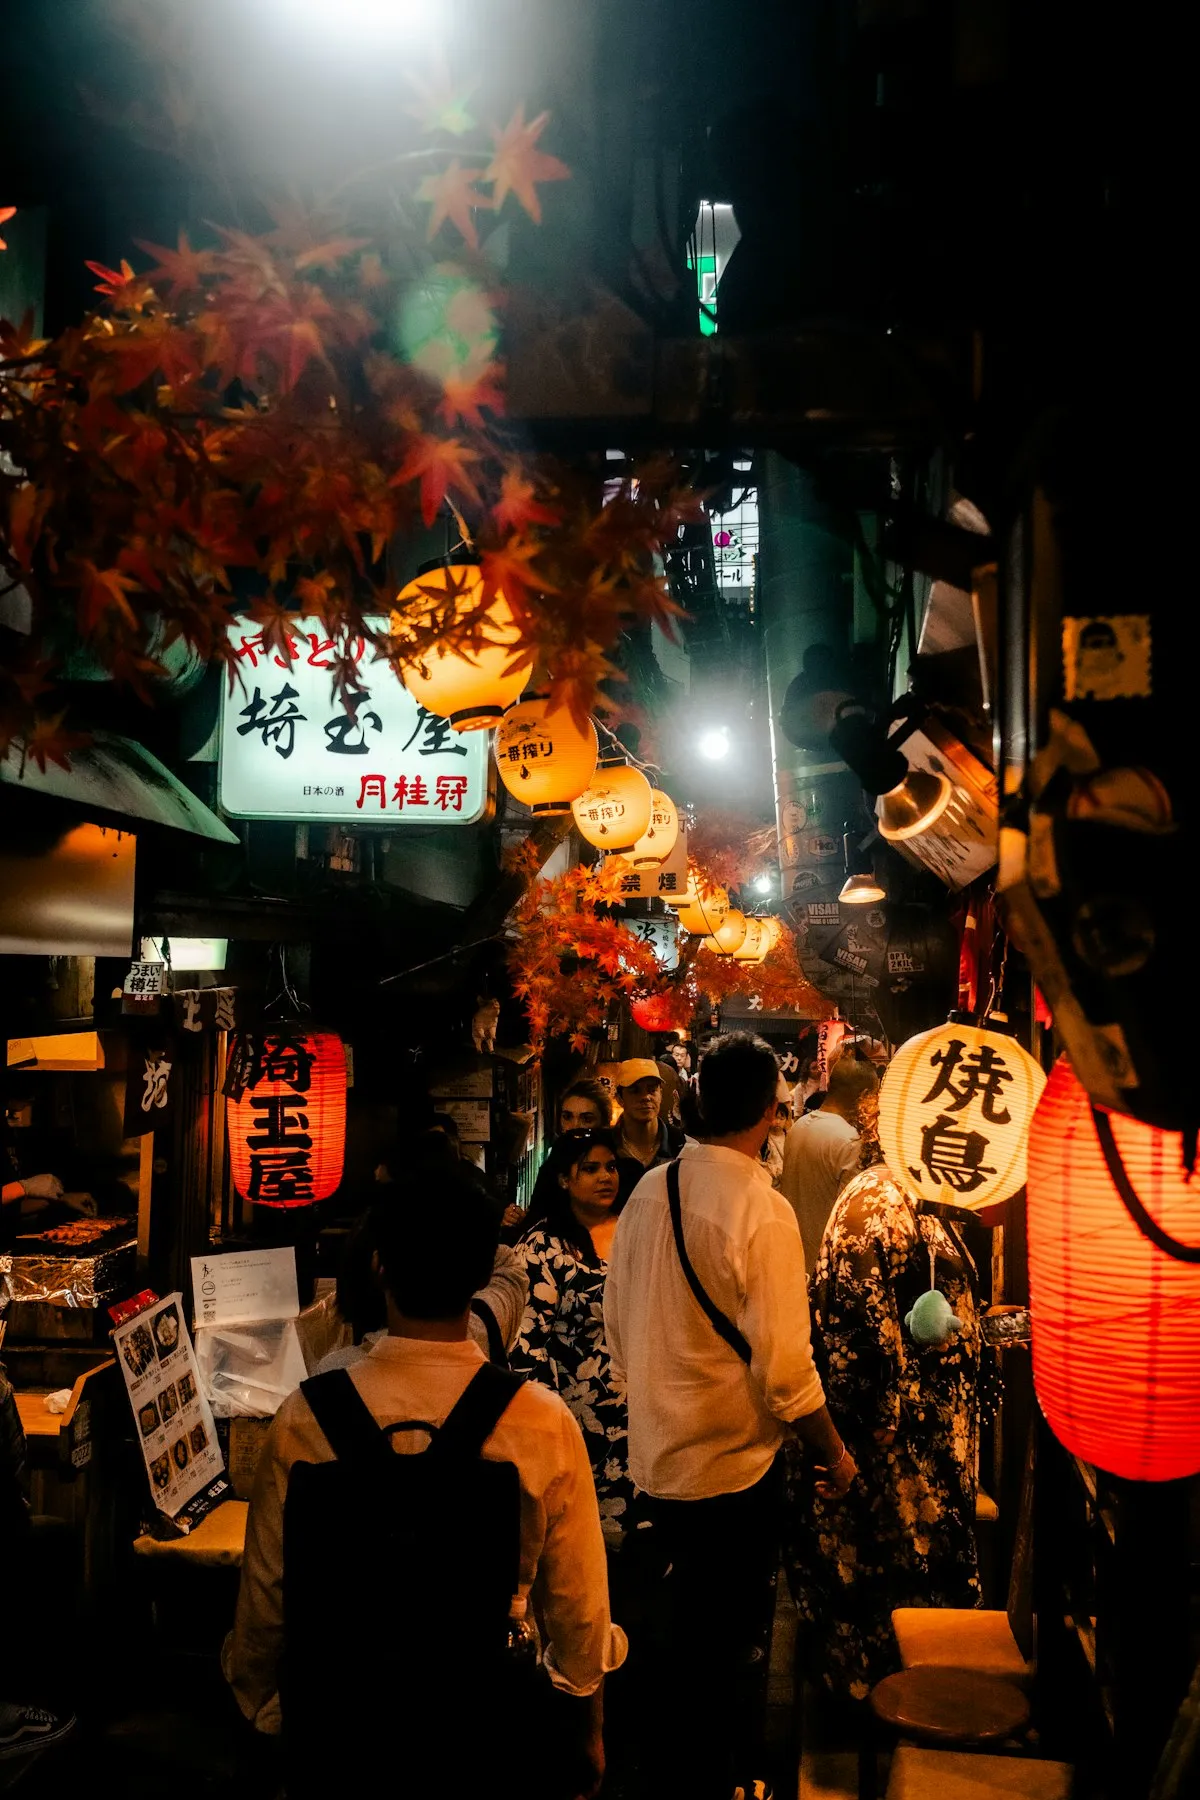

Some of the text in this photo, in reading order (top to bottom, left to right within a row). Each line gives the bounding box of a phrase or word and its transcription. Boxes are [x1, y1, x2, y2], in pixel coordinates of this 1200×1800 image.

[236, 682, 468, 759] 埼玉屋
[499, 741, 553, 762] 一番搾り
[303, 785, 345, 796] 日本の酒
[356, 774, 468, 811] 月桂冠
[579, 804, 625, 821] 一番搾り
[130, 977, 158, 992] 樽生
[908, 1039, 1014, 1193] 焼鳥
